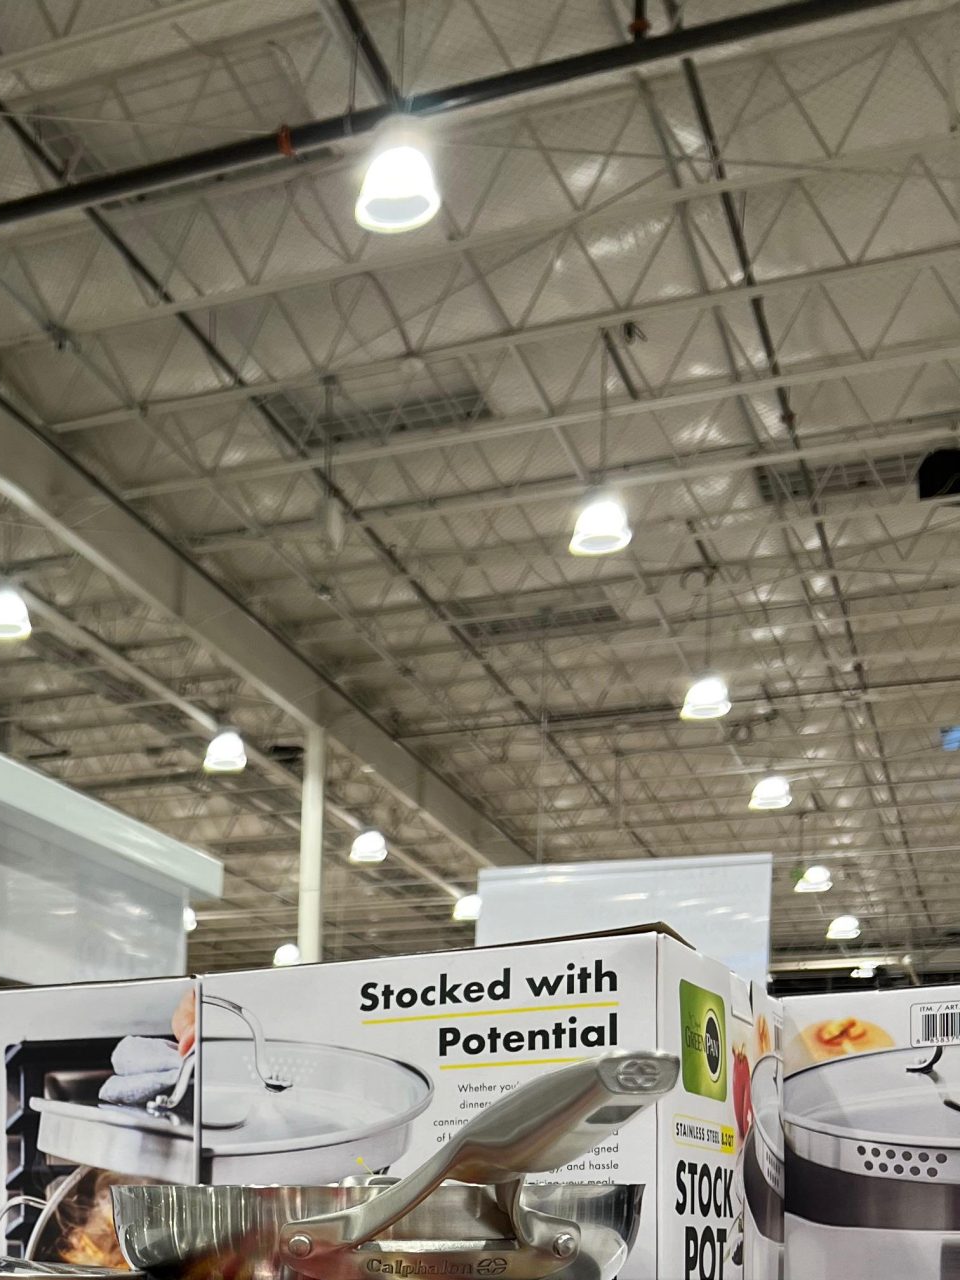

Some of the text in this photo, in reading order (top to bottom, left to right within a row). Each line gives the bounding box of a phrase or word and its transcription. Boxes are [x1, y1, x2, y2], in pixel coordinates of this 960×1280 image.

[359, 959, 617, 1012] Stocked with
[439, 1012, 617, 1057] Potential
[457, 1083, 496, 1093] Whether
[436, 1133, 445, 1142] of
[676, 1122, 720, 1144] STAINLESS STEEL
[566, 1159, 619, 1171] and hassle
[675, 1159, 733, 1218] STOCK
[685, 1225, 727, 1280] POT
[366, 1258, 473, 1278] Calphalon
